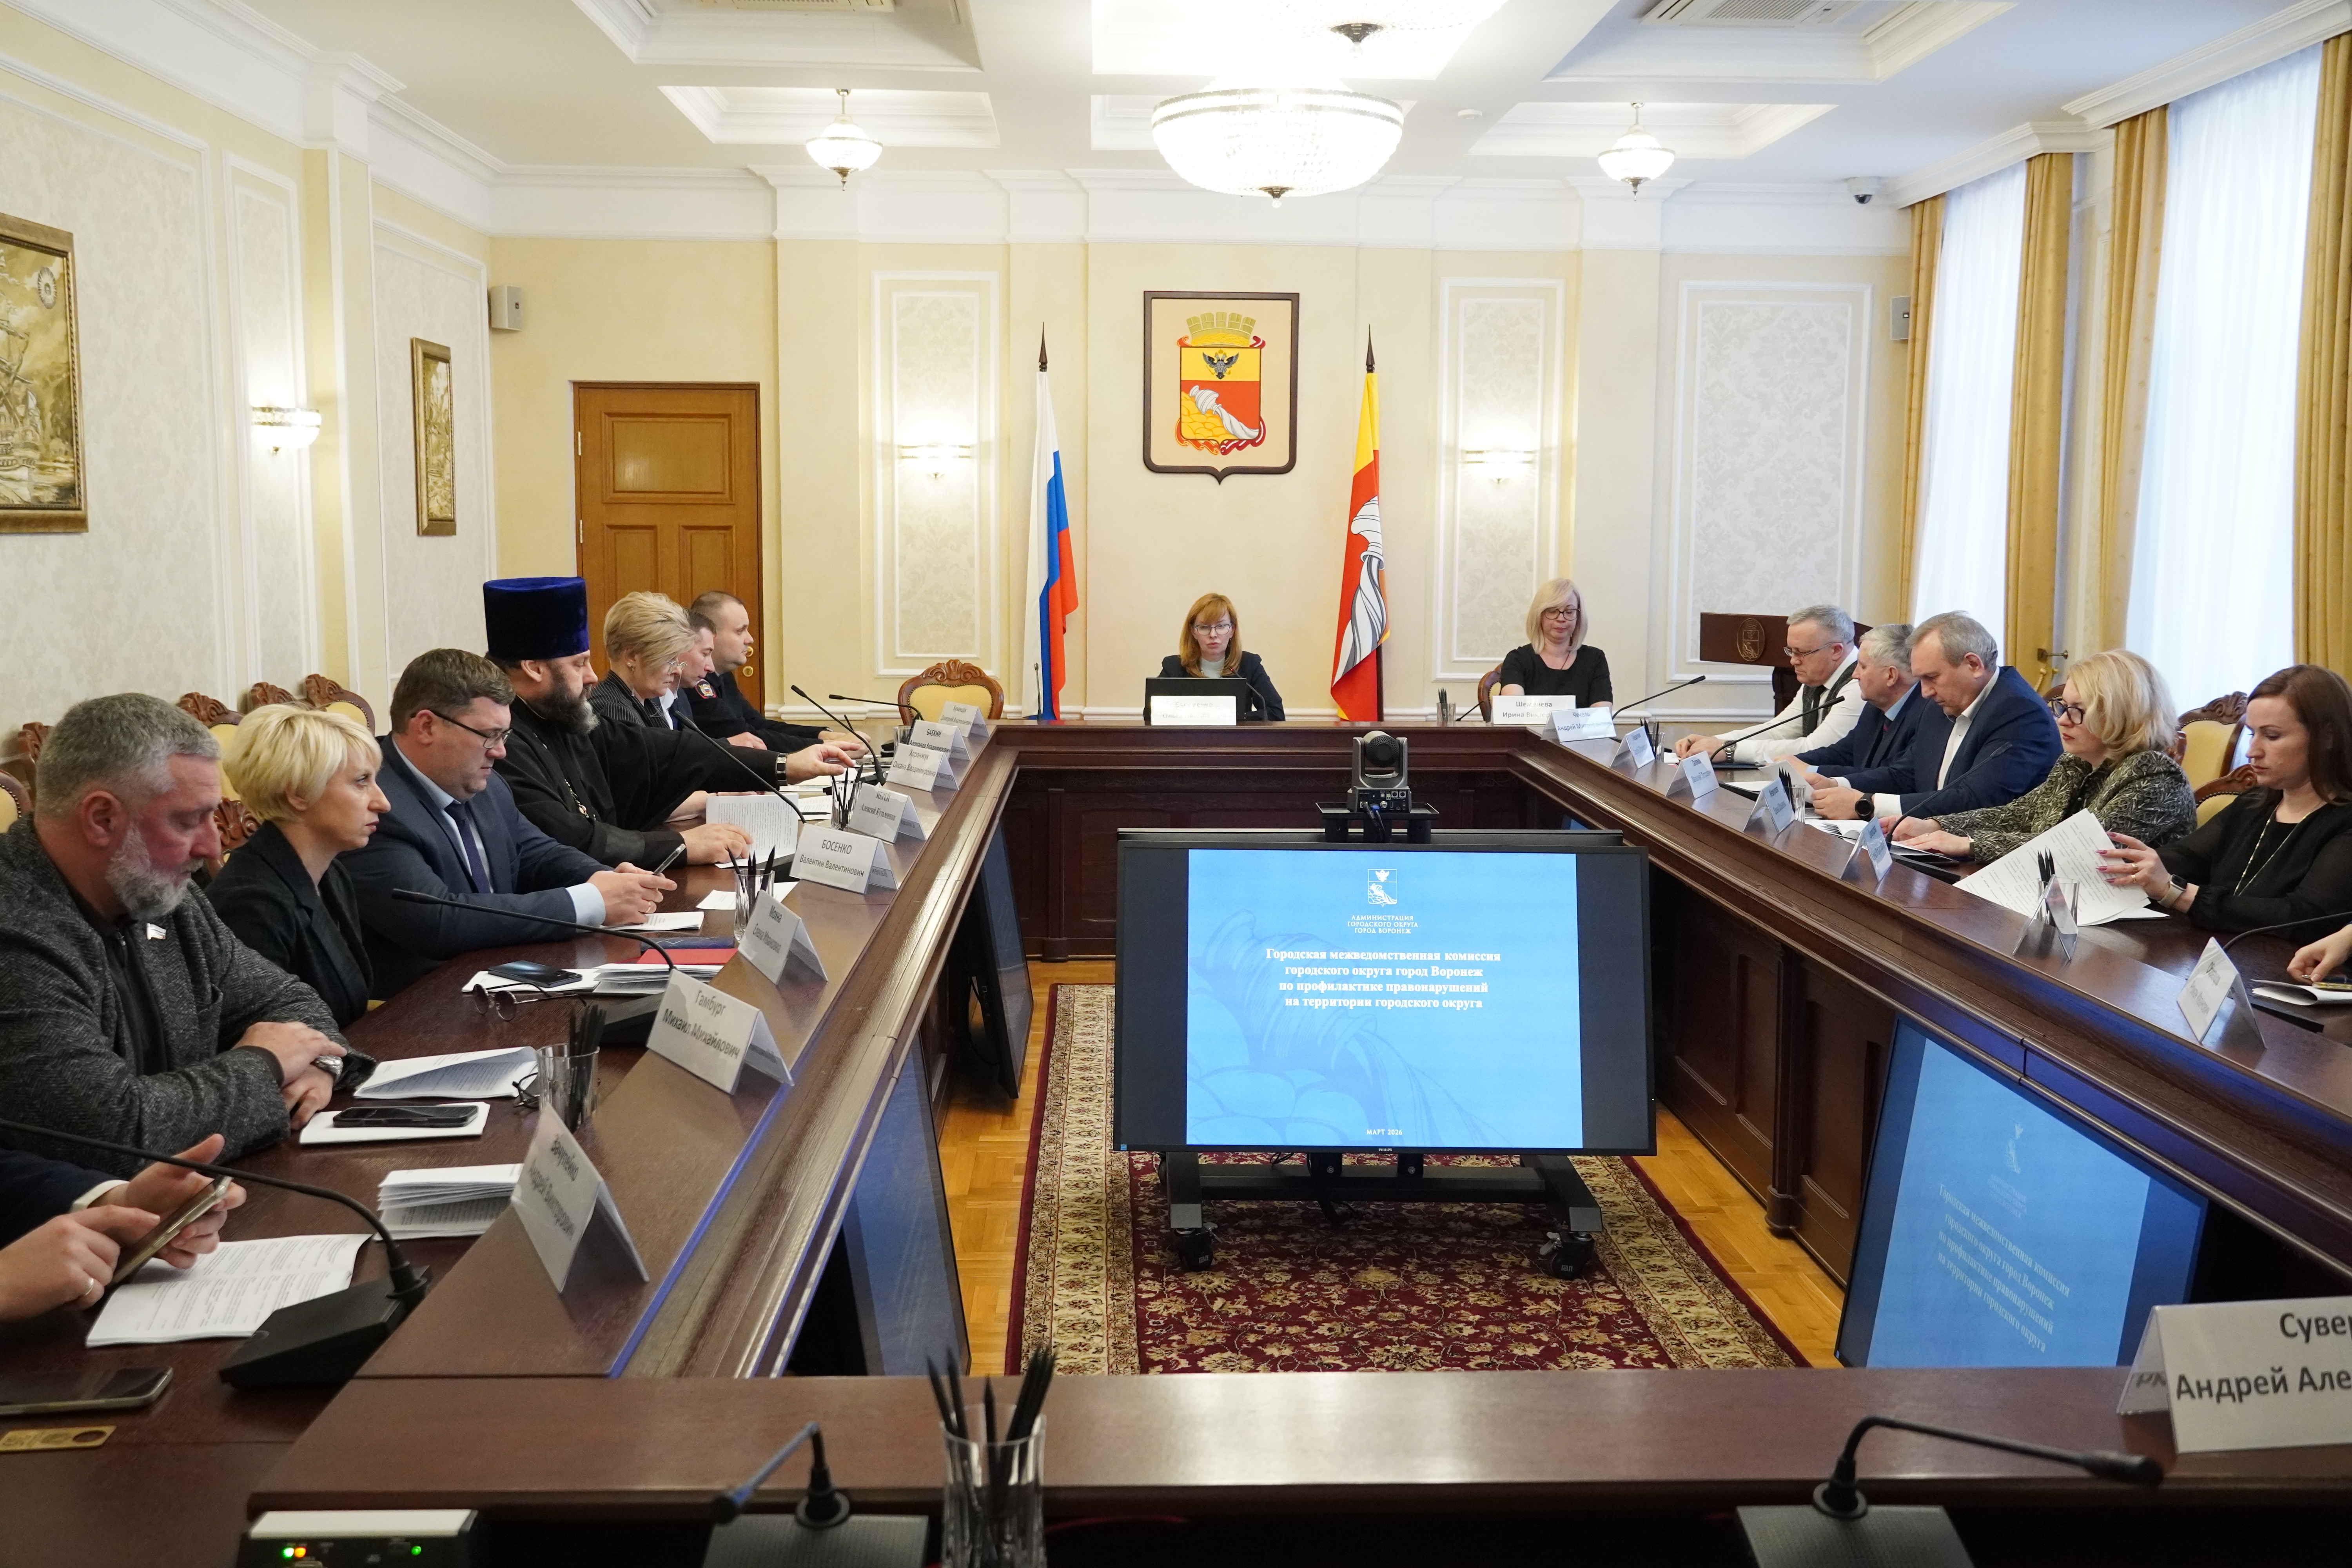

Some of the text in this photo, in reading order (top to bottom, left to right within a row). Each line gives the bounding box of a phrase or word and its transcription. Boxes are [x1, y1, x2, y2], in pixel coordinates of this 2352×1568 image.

[926, 729, 941, 737] БАБКИН
[1557, 723, 1576, 731] Андрей
[909, 749, 929, 761] Хоронжук
[893, 760, 907, 770] Оксана
[906, 764, 936, 777] Владимировна
[821, 839, 852, 855] БОСЕНКО
[800, 854, 864, 877] Валентин Валентинович
[1266, 948, 1501, 962] Городская межведомственная комиссия
[1285, 966, 1483, 979] городского округа город Воронеж
[1279, 981, 1488, 995] по профилактике правонарушений
[695, 989, 726, 1018] Гамбург
[1285, 998, 1483, 1011] на территории городского округа
[663, 1009, 740, 1059] Михаил Михайлович
[2279, 1312, 2352, 1344] Суве
[2176, 1366, 2289, 1404] Андрей
